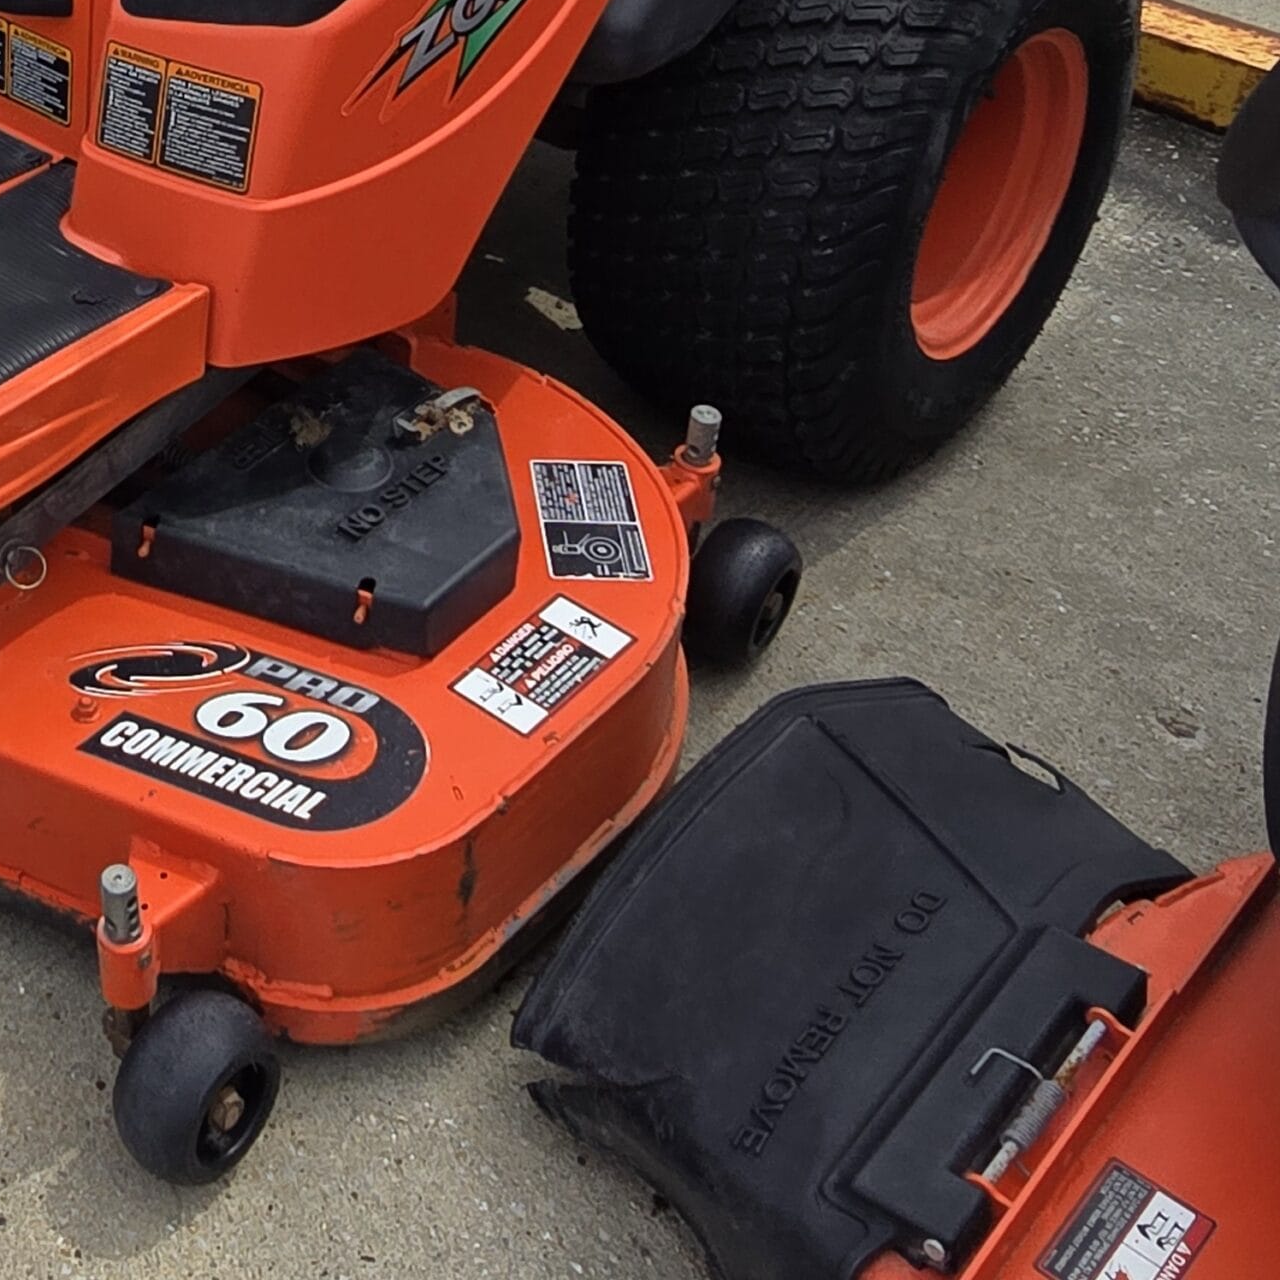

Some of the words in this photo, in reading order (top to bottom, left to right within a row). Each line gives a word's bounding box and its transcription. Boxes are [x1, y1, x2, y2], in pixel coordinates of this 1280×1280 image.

[119, 48, 160, 69] WARNING
[182, 69, 251, 94] ADVERTENCIA
[337, 503, 387, 542] NO
[380, 454, 449, 510] STEP
[497, 622, 536, 657] DANGER
[530, 643, 575, 682] PELIGRO
[243, 656, 382, 715] PRO
[195, 691, 352, 763] 60
[99, 720, 328, 820] COMMERCIAL
[893, 891, 948, 936] DO
[836, 943, 906, 1009] NOT
[730, 1005, 849, 1158] REMOVE
